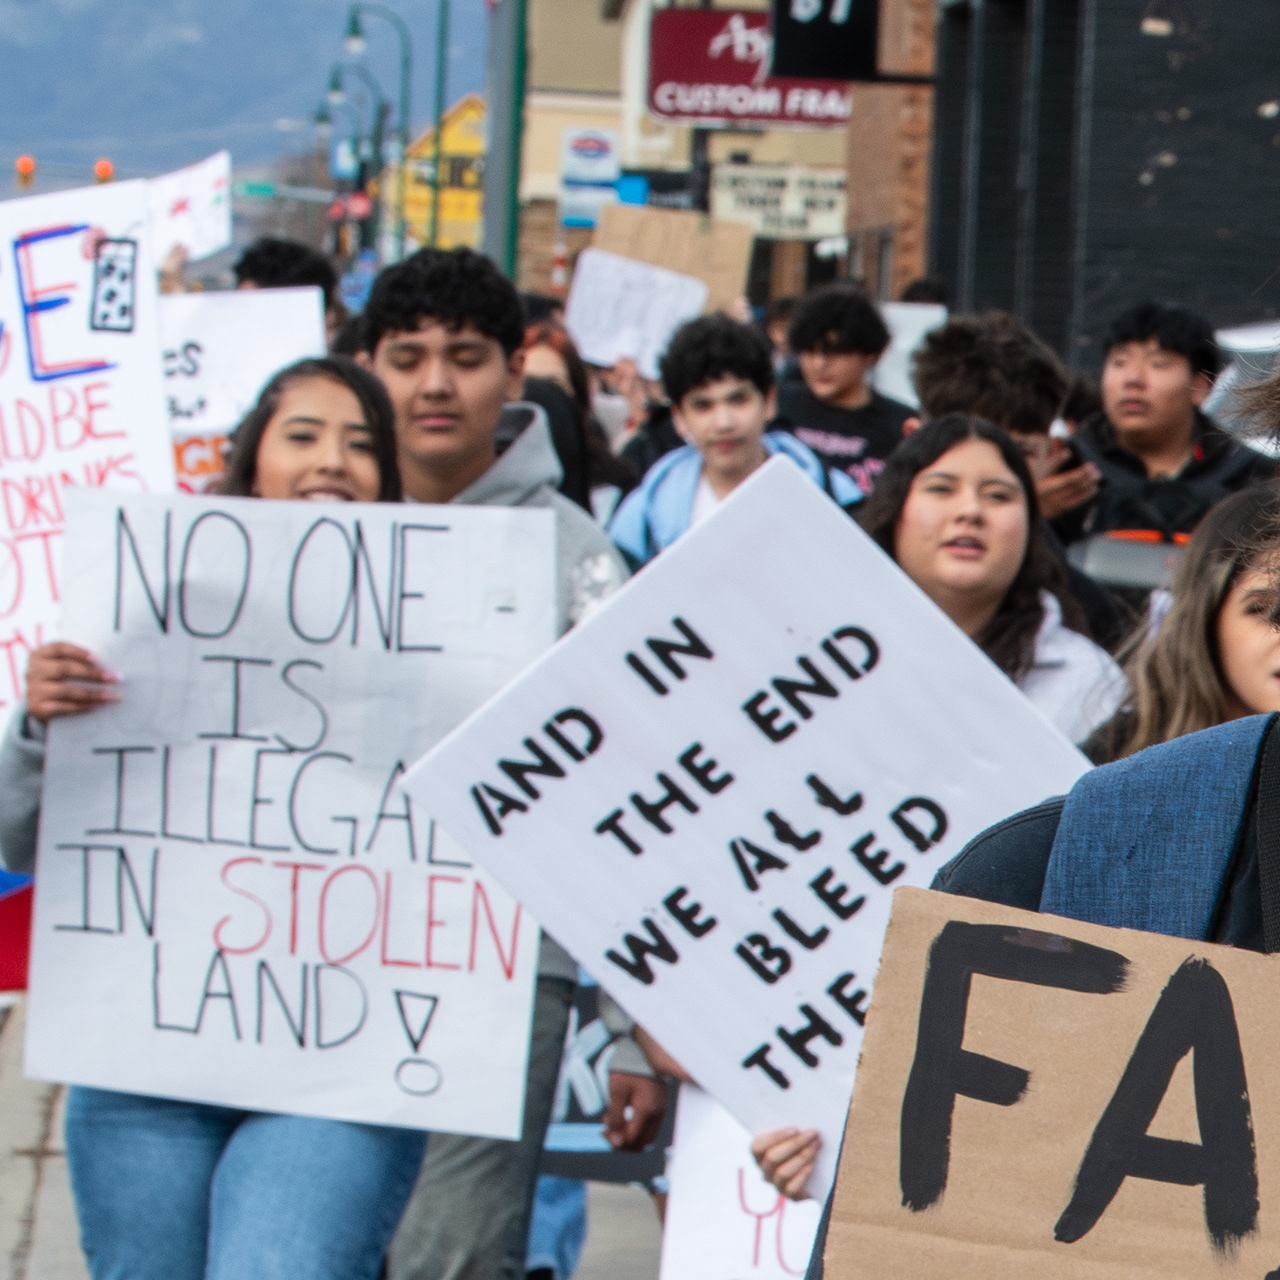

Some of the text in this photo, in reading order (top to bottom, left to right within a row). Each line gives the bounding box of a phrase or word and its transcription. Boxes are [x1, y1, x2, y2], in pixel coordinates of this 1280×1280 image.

[785, 87, 853, 118] FRA
[48, 382, 127, 452] BE
[114, 506, 252, 639] NO
[288, 516, 450, 652] ONE
[198, 655, 328, 752] IS
[469, 616, 716, 836] AND IN
[596, 625, 881, 856] THE END
[85, 744, 473, 869] ILLEGAL
[54, 844, 523, 981] IN STOLEN
[605, 774, 864, 986] WE ALL
[735, 795, 949, 984] BLEED
